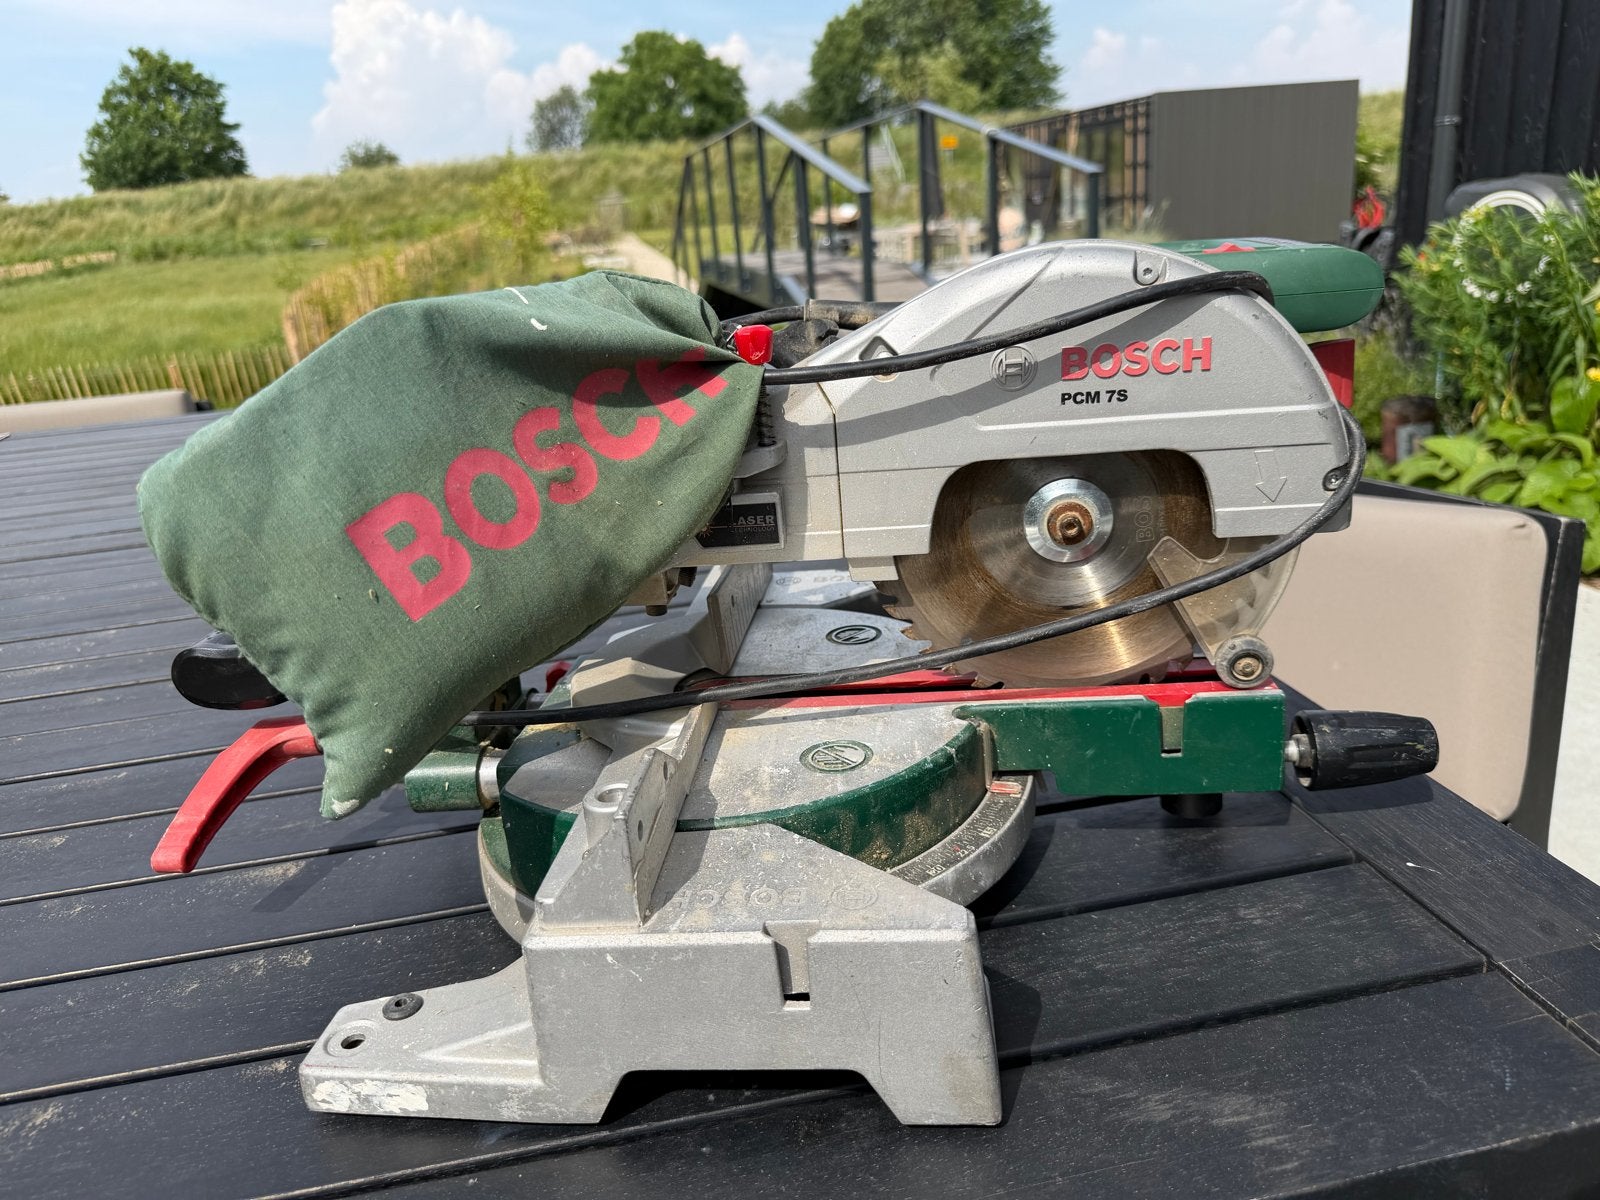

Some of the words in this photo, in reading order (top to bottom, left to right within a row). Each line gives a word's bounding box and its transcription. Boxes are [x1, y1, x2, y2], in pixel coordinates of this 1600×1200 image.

[1061, 336, 1213, 381] BOSCH
[1060, 390, 1101, 406] PCM
[1105, 388, 1129, 403] 7S
[345, 345, 729, 622] BOSCH
[733, 514, 775, 526] ASER
